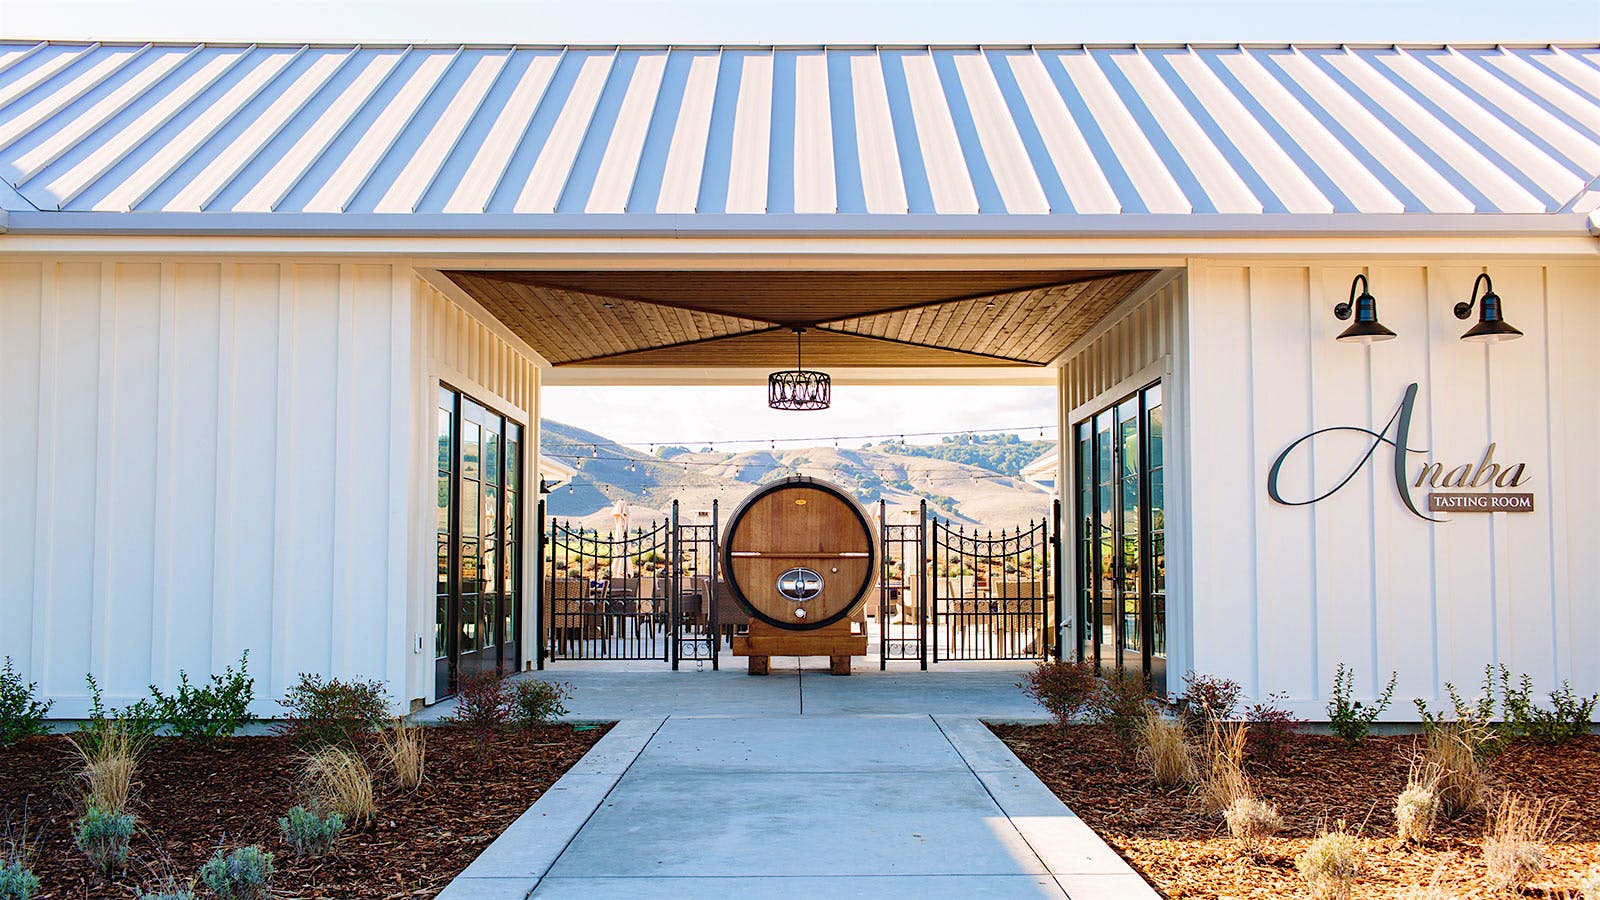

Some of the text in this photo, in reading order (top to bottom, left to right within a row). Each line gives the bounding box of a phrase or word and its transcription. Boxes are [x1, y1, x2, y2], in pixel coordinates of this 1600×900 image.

[1267, 382, 1532, 522] Anaba
[1434, 496, 1531, 507] TASTING ROOM
